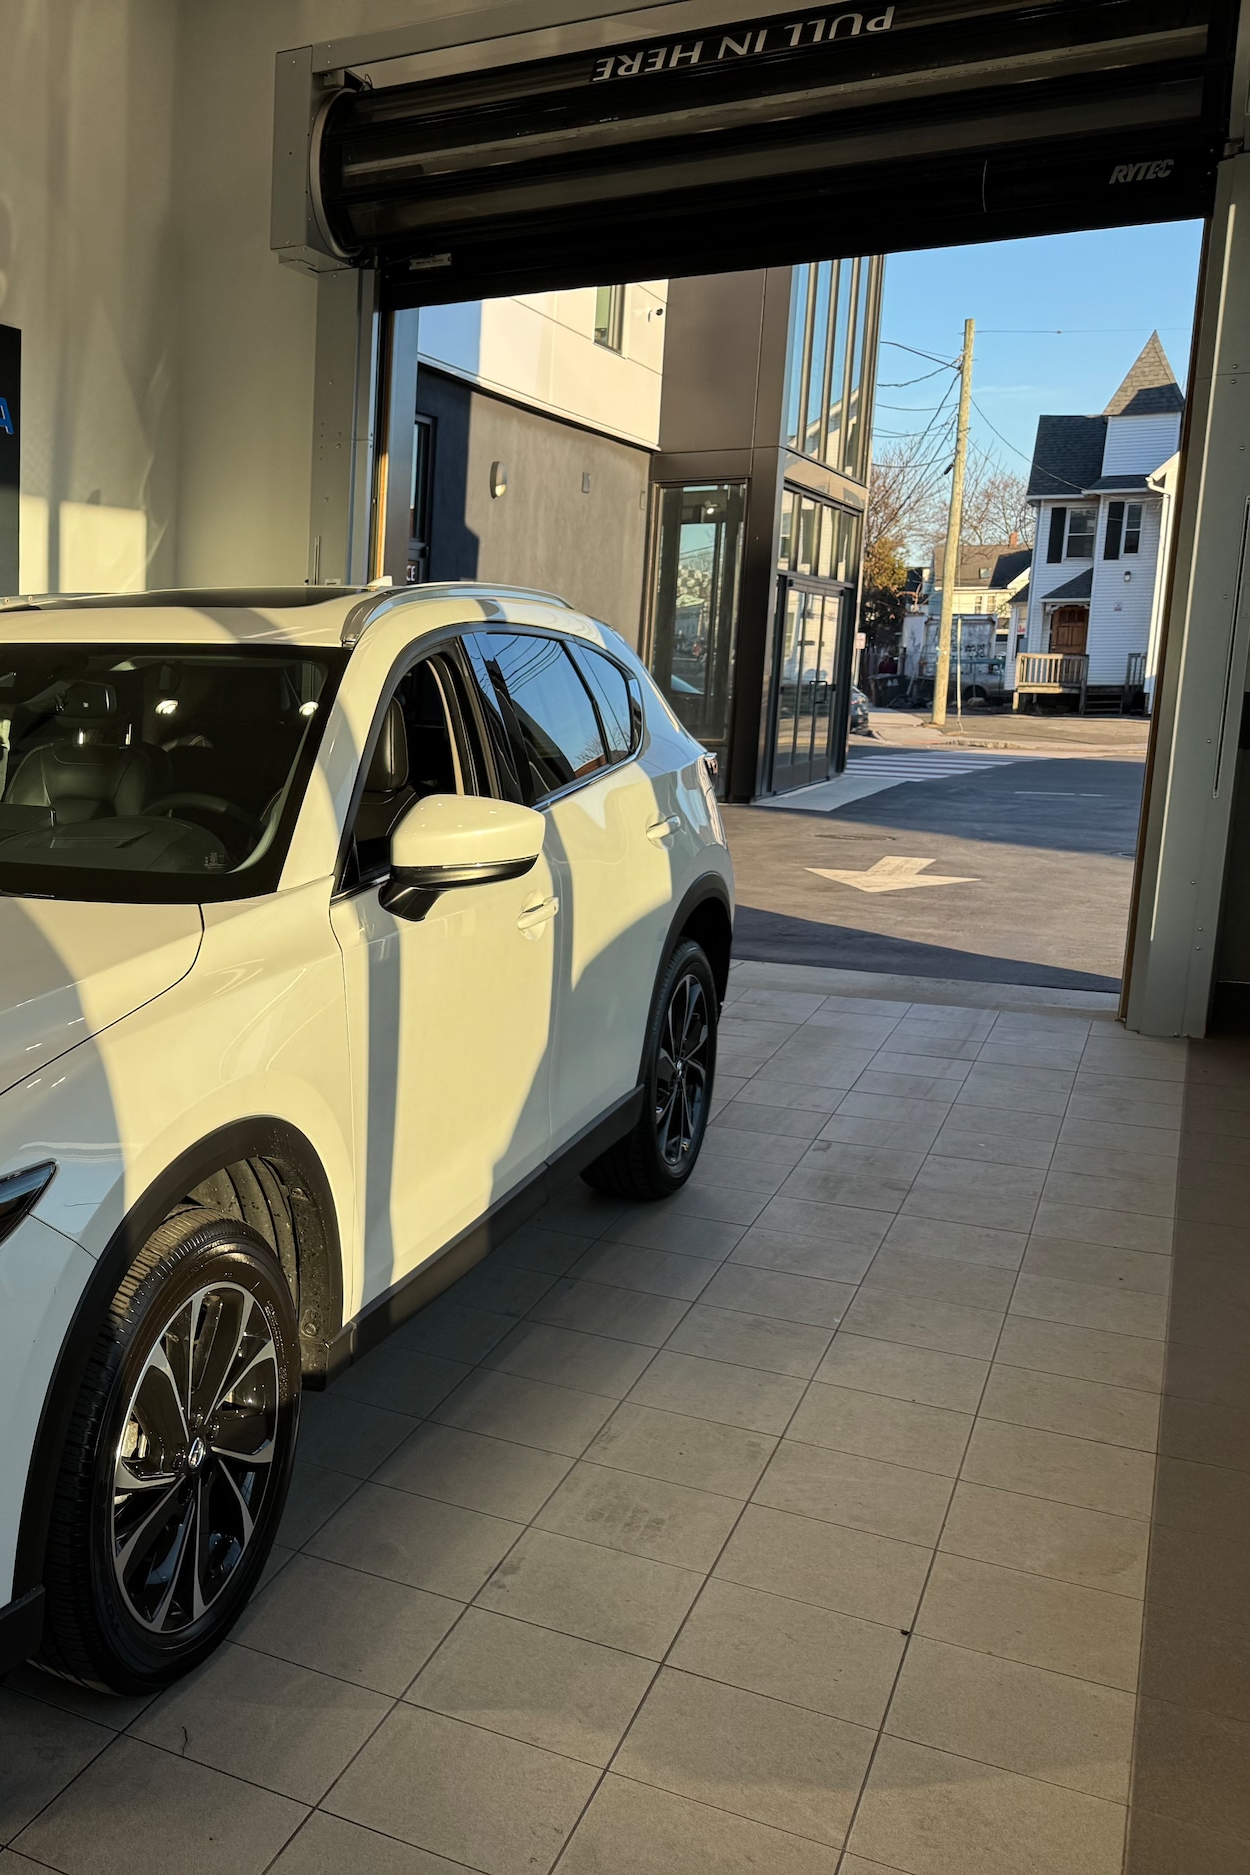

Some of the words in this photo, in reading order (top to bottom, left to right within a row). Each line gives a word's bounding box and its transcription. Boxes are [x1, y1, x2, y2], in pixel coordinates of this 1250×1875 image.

[717, 29, 768, 60] IN
[784, 6, 896, 47] PULL
[592, 41, 704, 82] HERE
[1108, 158, 1175, 185] RYTEC
